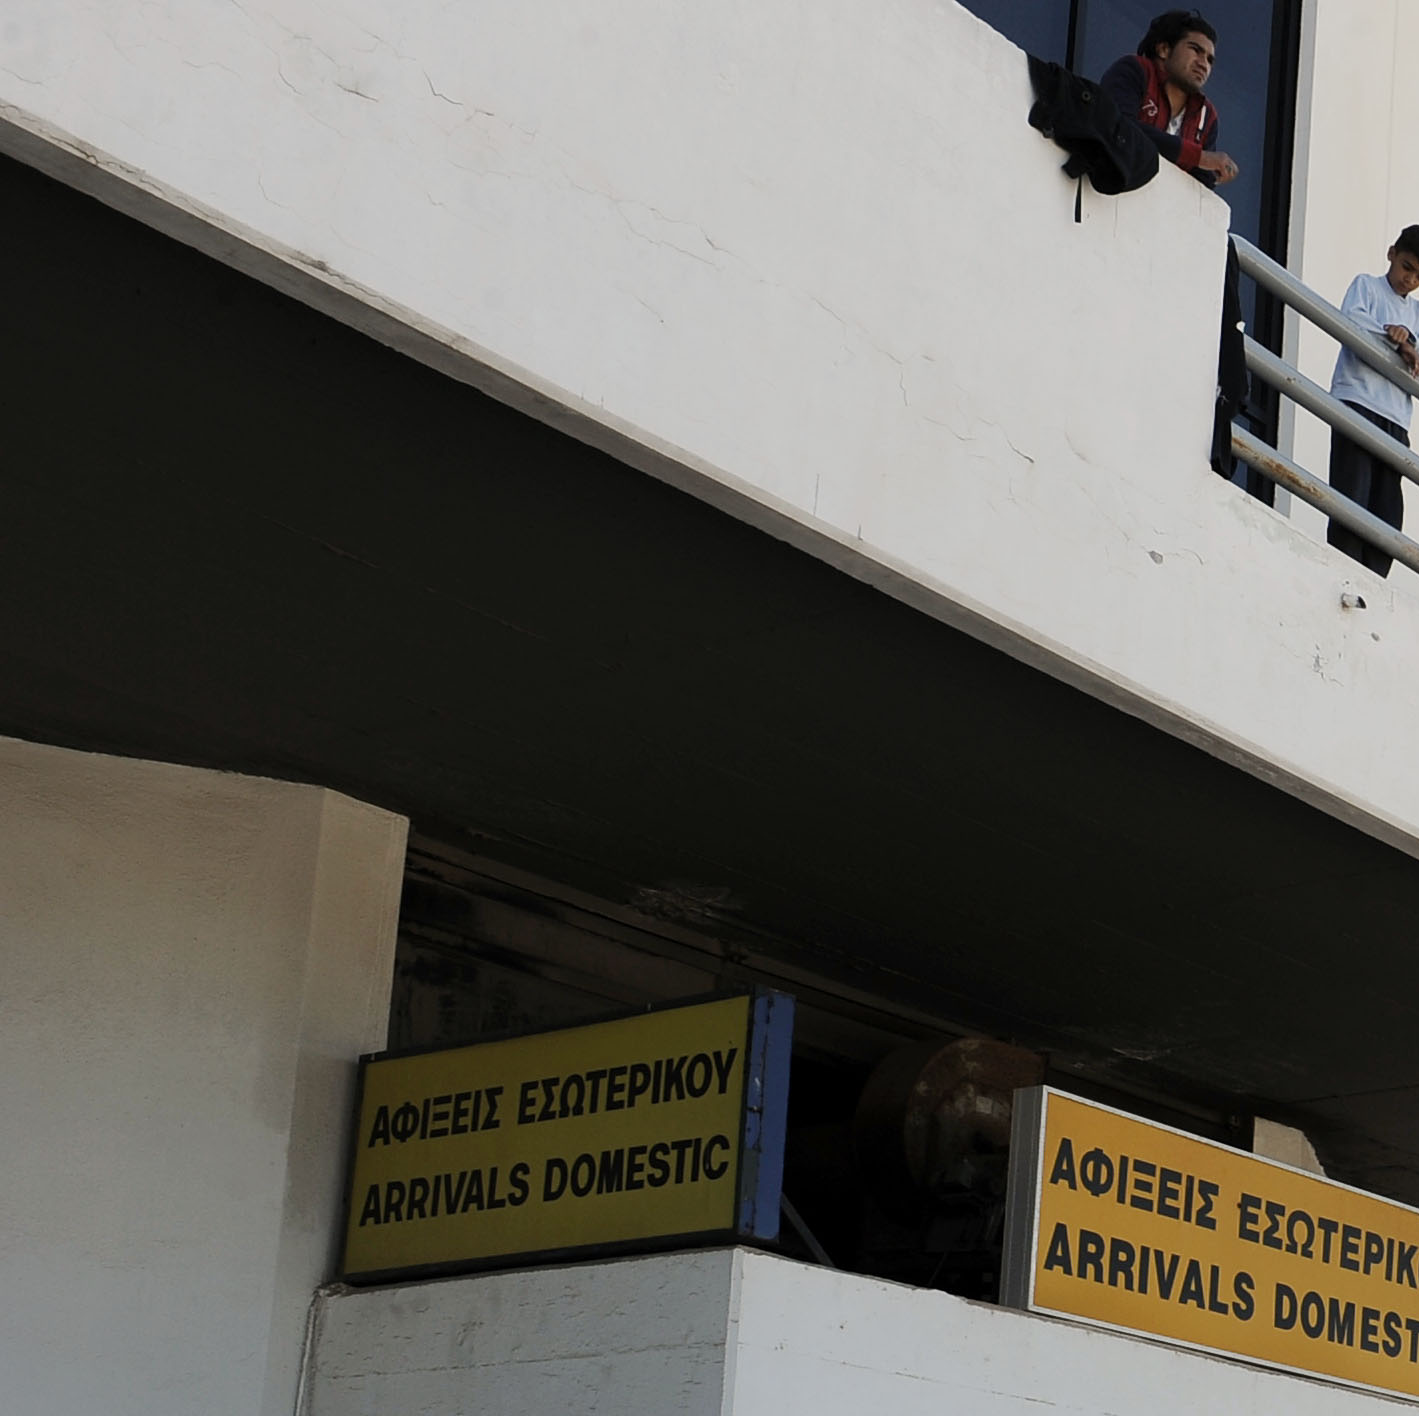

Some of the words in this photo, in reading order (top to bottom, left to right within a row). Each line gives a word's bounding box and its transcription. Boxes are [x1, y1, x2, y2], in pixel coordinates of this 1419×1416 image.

[367, 1086, 504, 1148] ΑΦΙΞΕΙΣ
[517, 1047, 739, 1125] ΕΣΩΤΕΡΙΚΟΥ
[359, 1161, 530, 1227] ARRIVALS
[543, 1134, 731, 1203] DOMESTIC
[1049, 1137, 1220, 1230] ΑΦΙΞΕΙΣ
[1044, 1222, 1255, 1321] ARRIVALS
